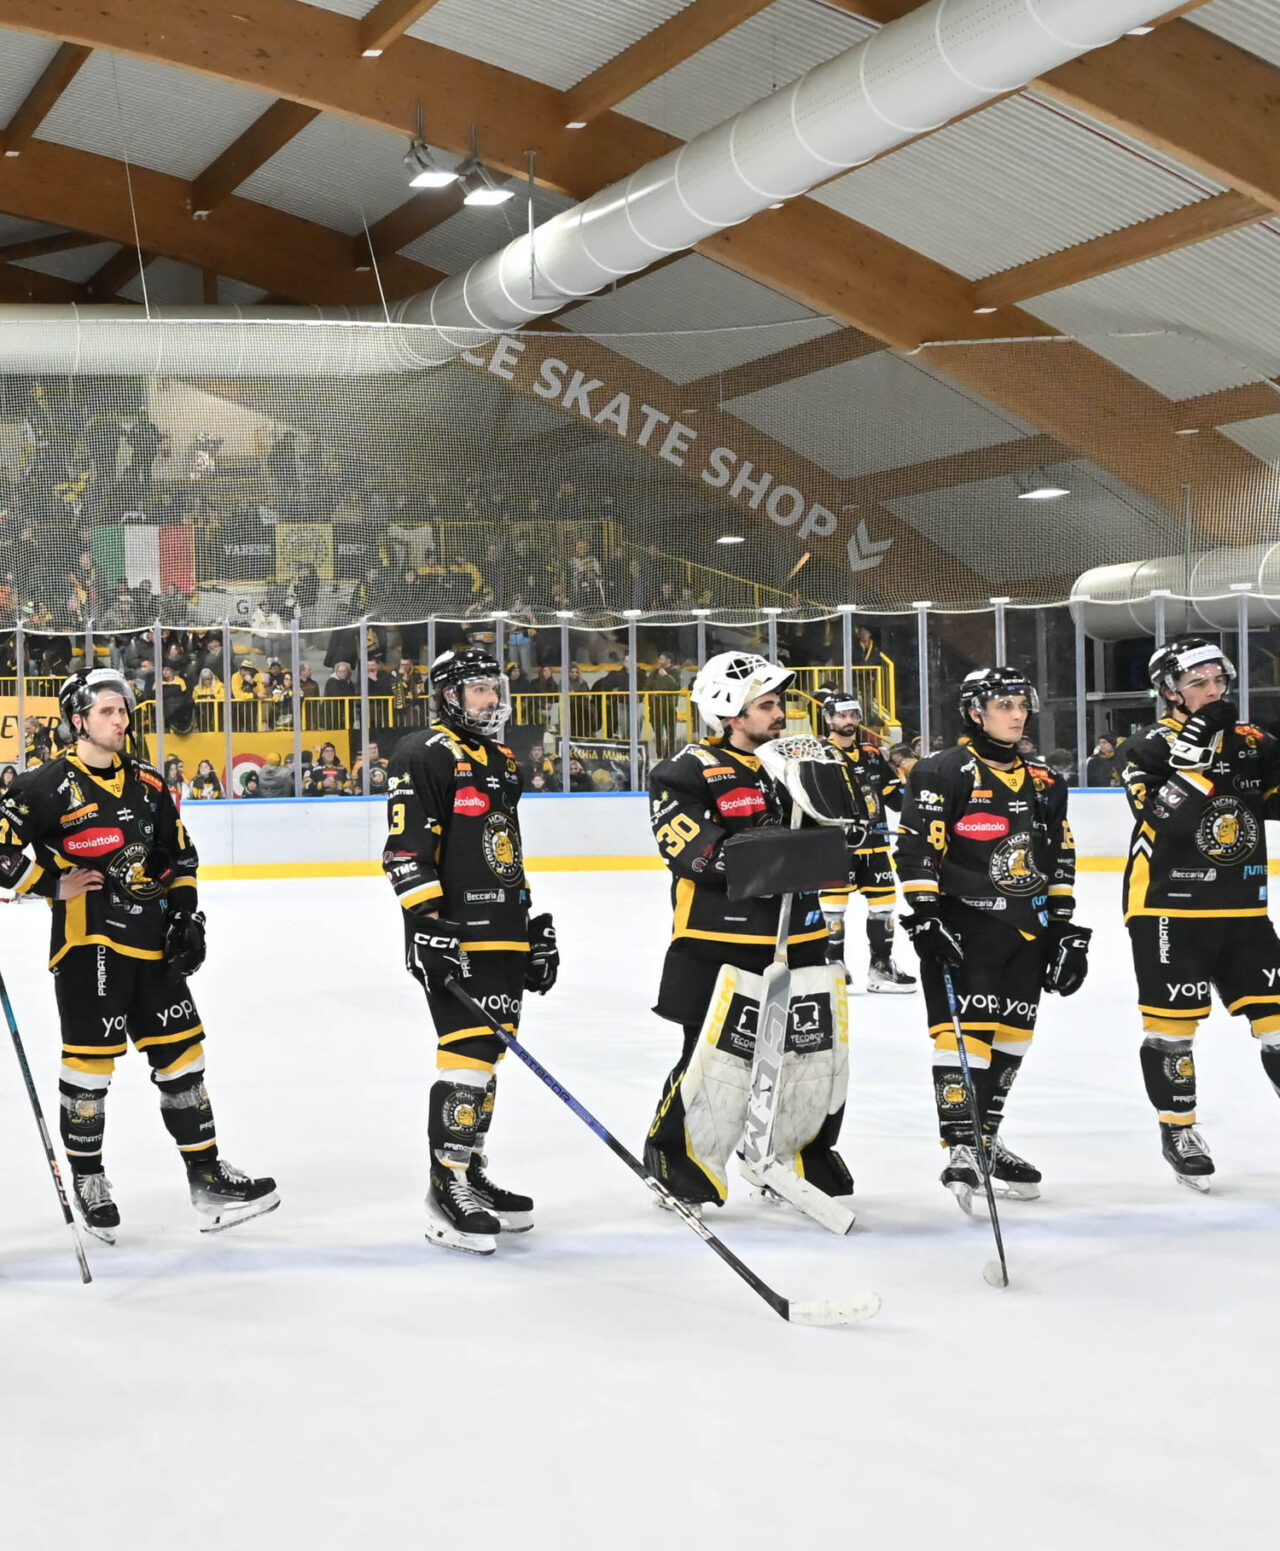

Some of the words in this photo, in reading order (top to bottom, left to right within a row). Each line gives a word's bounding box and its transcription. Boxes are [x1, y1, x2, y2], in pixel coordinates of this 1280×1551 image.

[533, 357, 697, 467] SKATE
[700, 446, 837, 539] SHOP
[1213, 797, 1238, 808] HCMV
[957, 822, 1006, 832] Scoiattolo
[1243, 811, 1257, 849] HOCKEY
[68, 834, 120, 850] Scoiattolo
[656, 813, 700, 858] 30
[393, 862, 418, 877] TMC
[1172, 870, 1204, 879] Beccaria
[467, 892, 497, 901] Beccaria
[1160, 916, 1170, 964] PRIMATO
[97, 945, 107, 997] PRIMATO
[790, 1031, 824, 1044] TECOBOX
